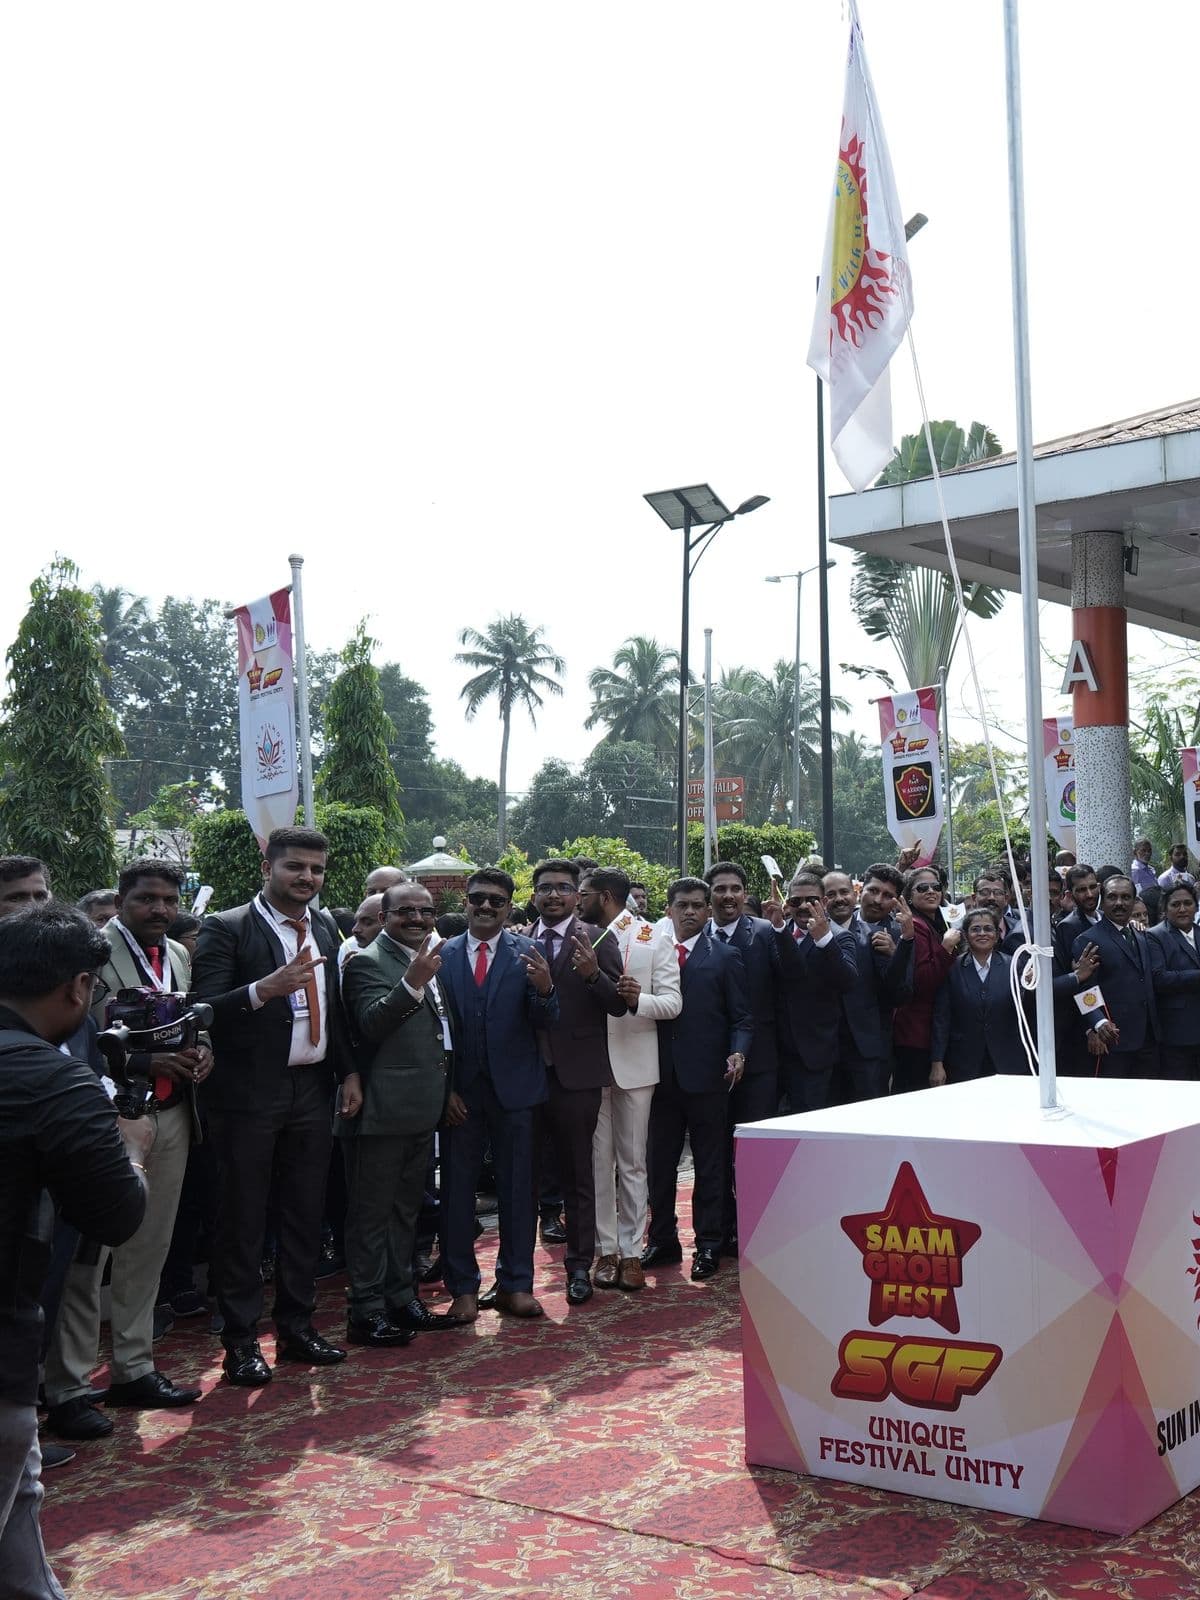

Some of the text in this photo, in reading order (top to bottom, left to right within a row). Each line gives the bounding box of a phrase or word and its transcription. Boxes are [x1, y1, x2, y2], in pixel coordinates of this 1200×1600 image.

[837, 164, 857, 196] EAM
[1060, 640, 1099, 694] A
[153, 1024, 182, 1041] RONIN
[865, 1224, 956, 1256] SAAM
[863, 1252, 961, 1286] GROEI
[882, 1283, 948, 1318] FEST
[837, 1338, 997, 1401] SGF
[868, 1415, 967, 1452] UNIQUE
[1157, 1407, 1187, 1457] SUN
[819, 1436, 1024, 1490] FESTIVAL UNITY
